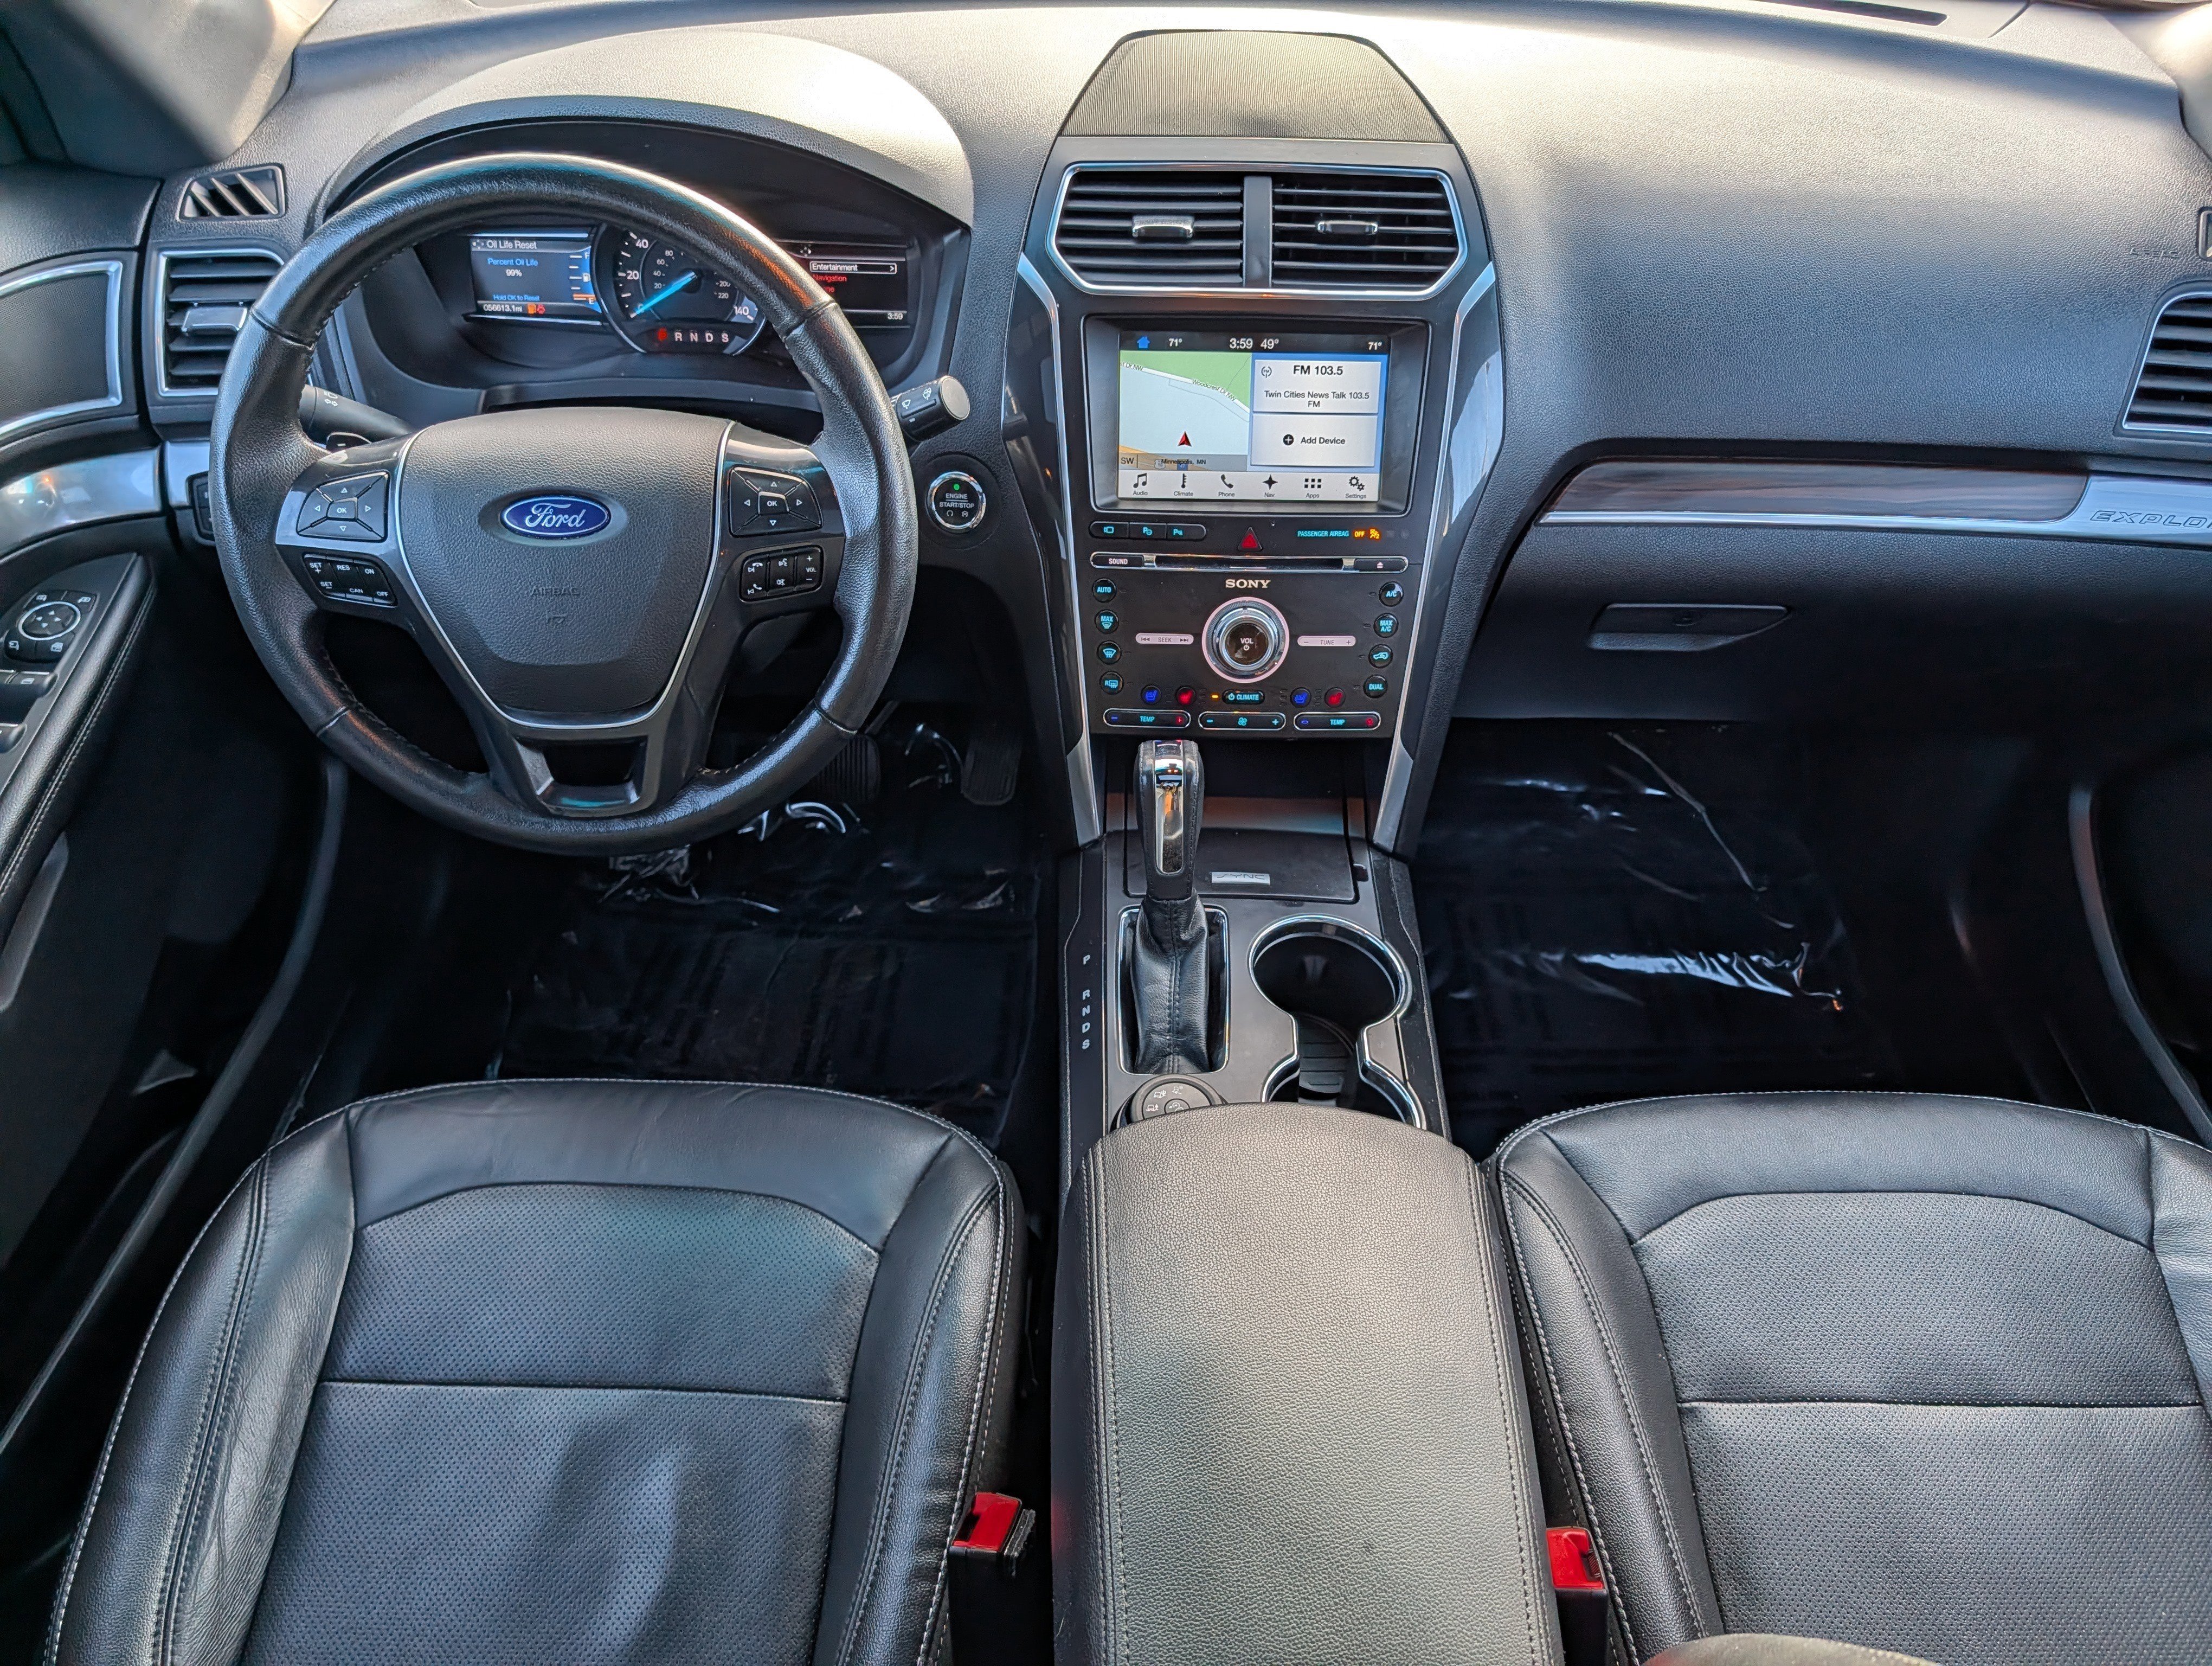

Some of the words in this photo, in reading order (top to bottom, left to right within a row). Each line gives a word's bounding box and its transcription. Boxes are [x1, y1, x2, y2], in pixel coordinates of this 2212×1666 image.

[487, 241, 497, 249] Oil
[499, 241, 513, 249] Life
[515, 241, 537, 249] Reset
[635, 239, 649, 248] 40
[812, 263, 858, 271] Entertainment
[627, 271, 639, 280] 20
[813, 274, 847, 283] Navigation
[734, 306, 749, 315] 140
[674, 332, 683, 342] R
[690, 332, 698, 342] N
[705, 333, 713, 343] D
[721, 332, 729, 343] S
[1229, 337, 1253, 349] 3:59
[1260, 338, 1279, 349] 49°
[1293, 365, 1310, 375] FM
[1314, 366, 1343, 375] 103.5
[1192, 379, 1220, 392] Woodcrest
[1226, 392, 1237, 402] NW
[1284, 390, 1305, 399] Cities
[1319, 437, 1346, 445] Device
[525, 502, 587, 528] Ford
[2089, 510, 2212, 529] EXPLO
[1225, 579, 1271, 589] SONY
[1083, 954, 1091, 965] P
[1082, 989, 1091, 1000] R
[1082, 1005, 1091, 1017] N
[1082, 1022, 1091, 1034] D
[1082, 1039, 1090, 1050] S
